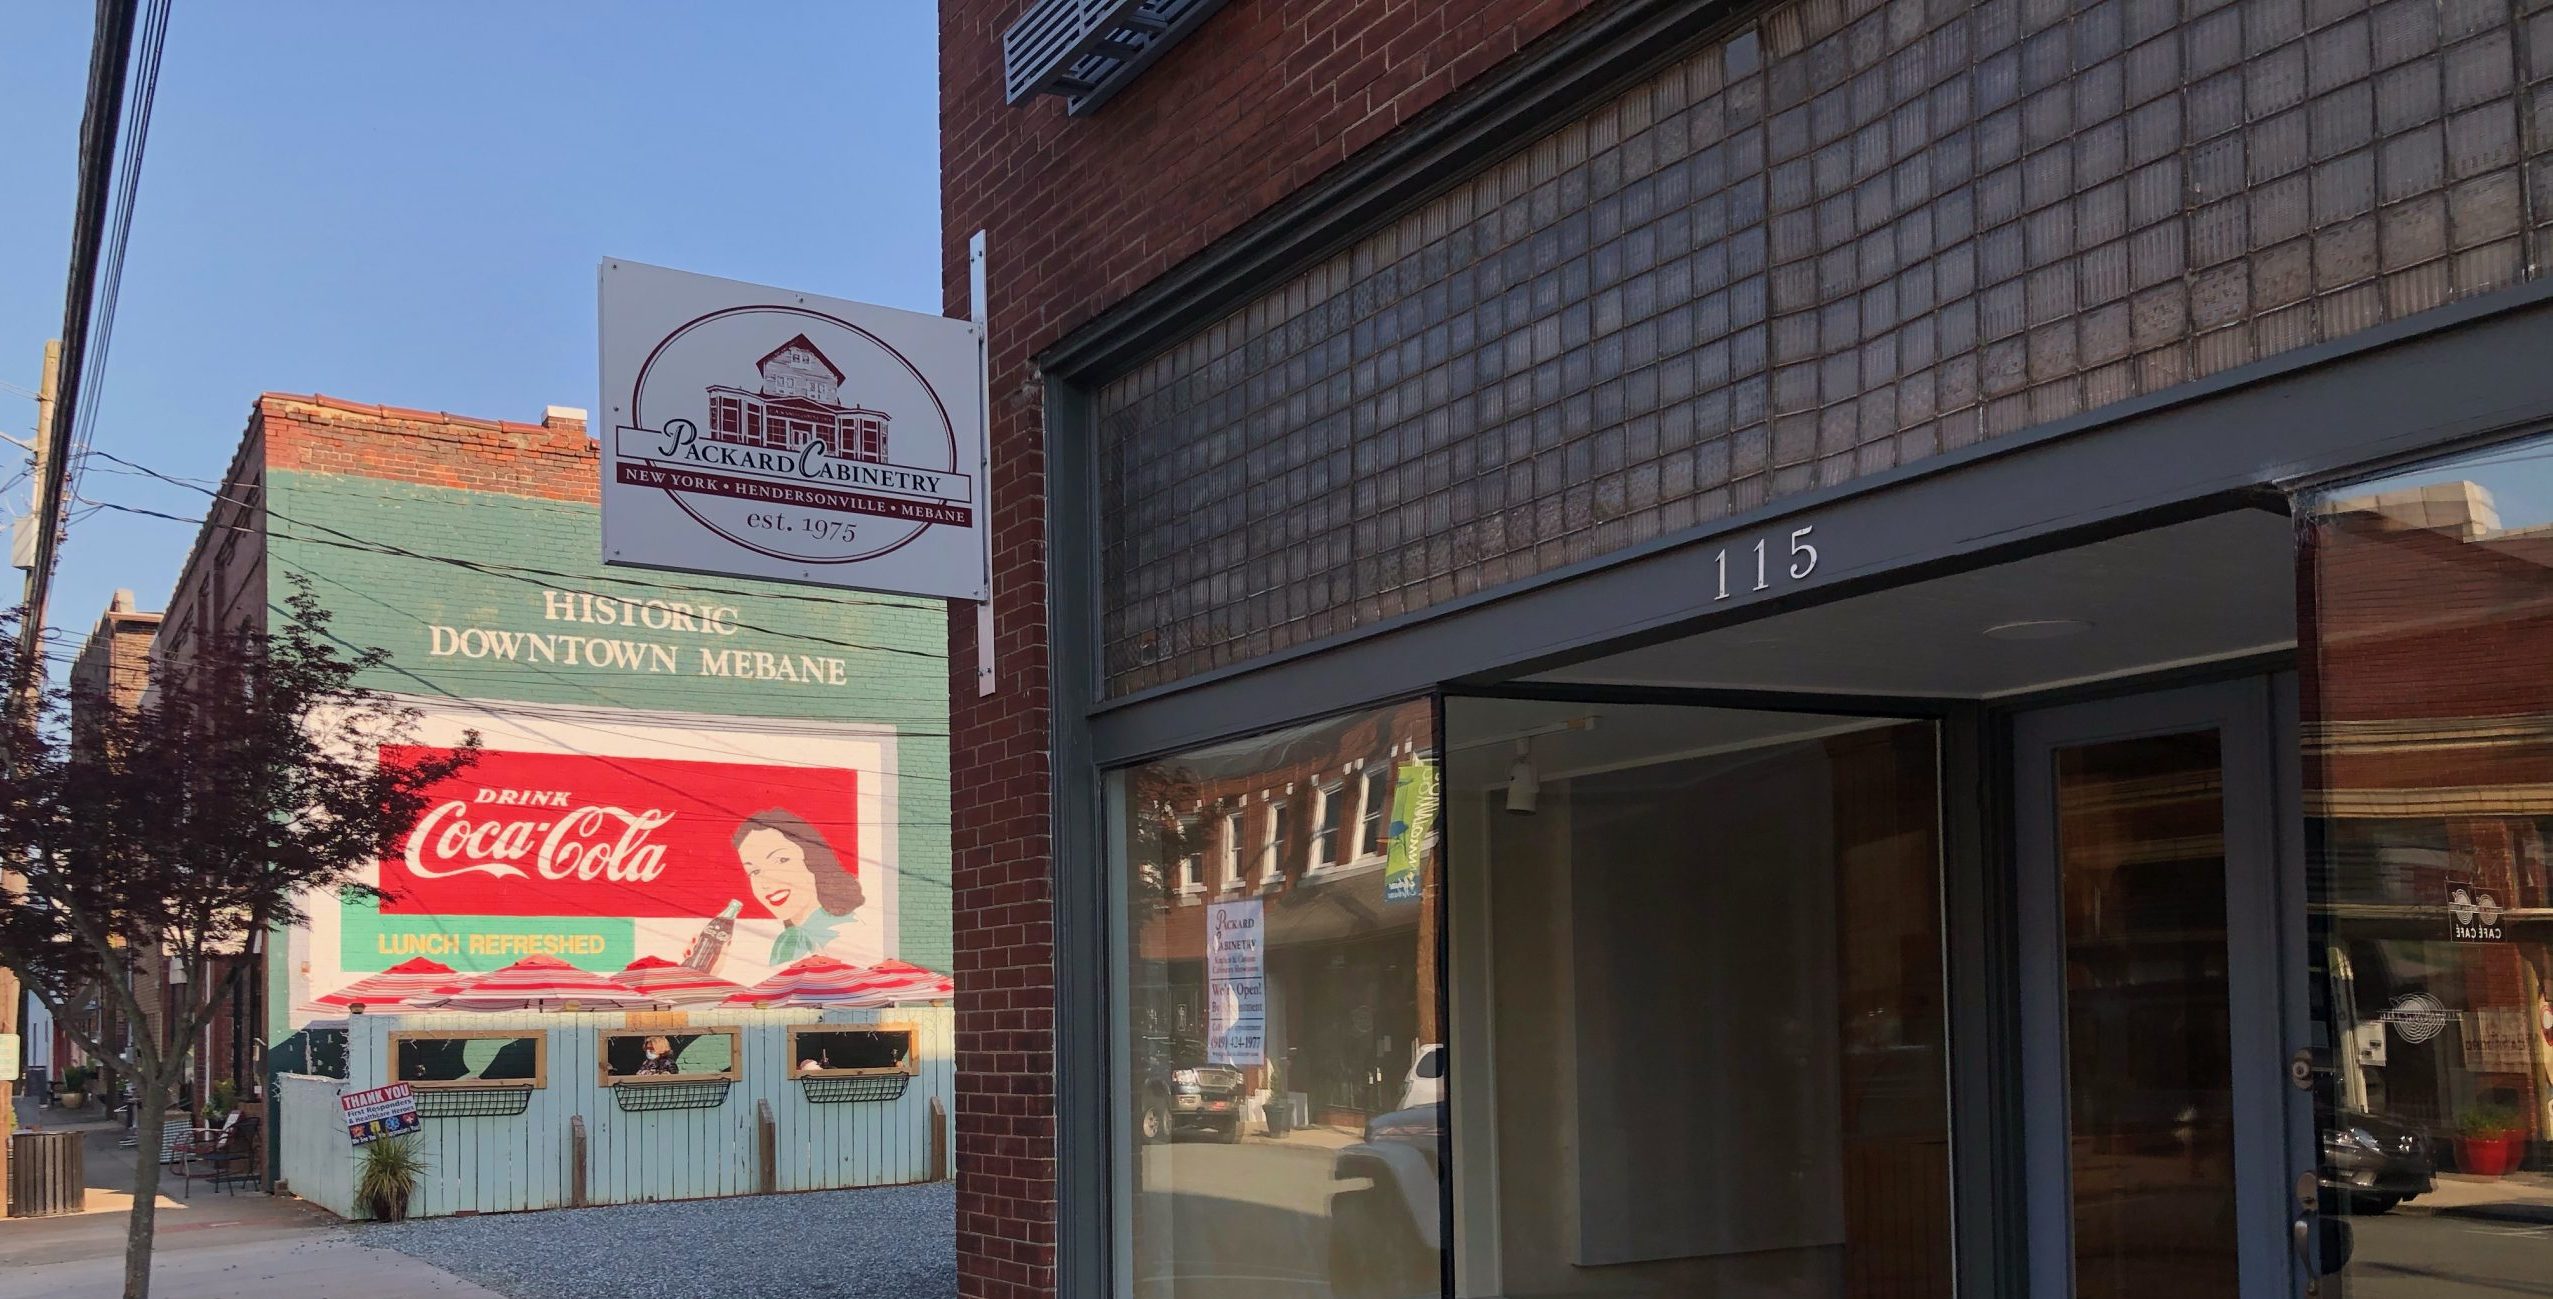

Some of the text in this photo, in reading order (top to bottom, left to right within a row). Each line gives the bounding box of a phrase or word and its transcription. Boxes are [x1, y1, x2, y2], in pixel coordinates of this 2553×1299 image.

[658, 418, 942, 493] PACKARD CABINETRY
[625, 468, 966, 523] NEW YORK HENDERSONVILLE MEBANE
[746, 512, 858, 543] est. 1975
[1713, 524, 1818, 601] 115
[543, 590, 739, 636] HISTORIC
[428, 625, 848, 686] DOWNTOWN MEBANE
[473, 787, 573, 808] DRINK
[404, 799, 678, 884] Coca-Cola
[378, 932, 606, 956] LUNCH REFRESHED
[1236, 982, 1262, 999] Open!
[343, 1084, 410, 1109] THANK YOU
[347, 1099, 412, 1118] First Responders
[355, 1111, 390, 1124] Healthcare
